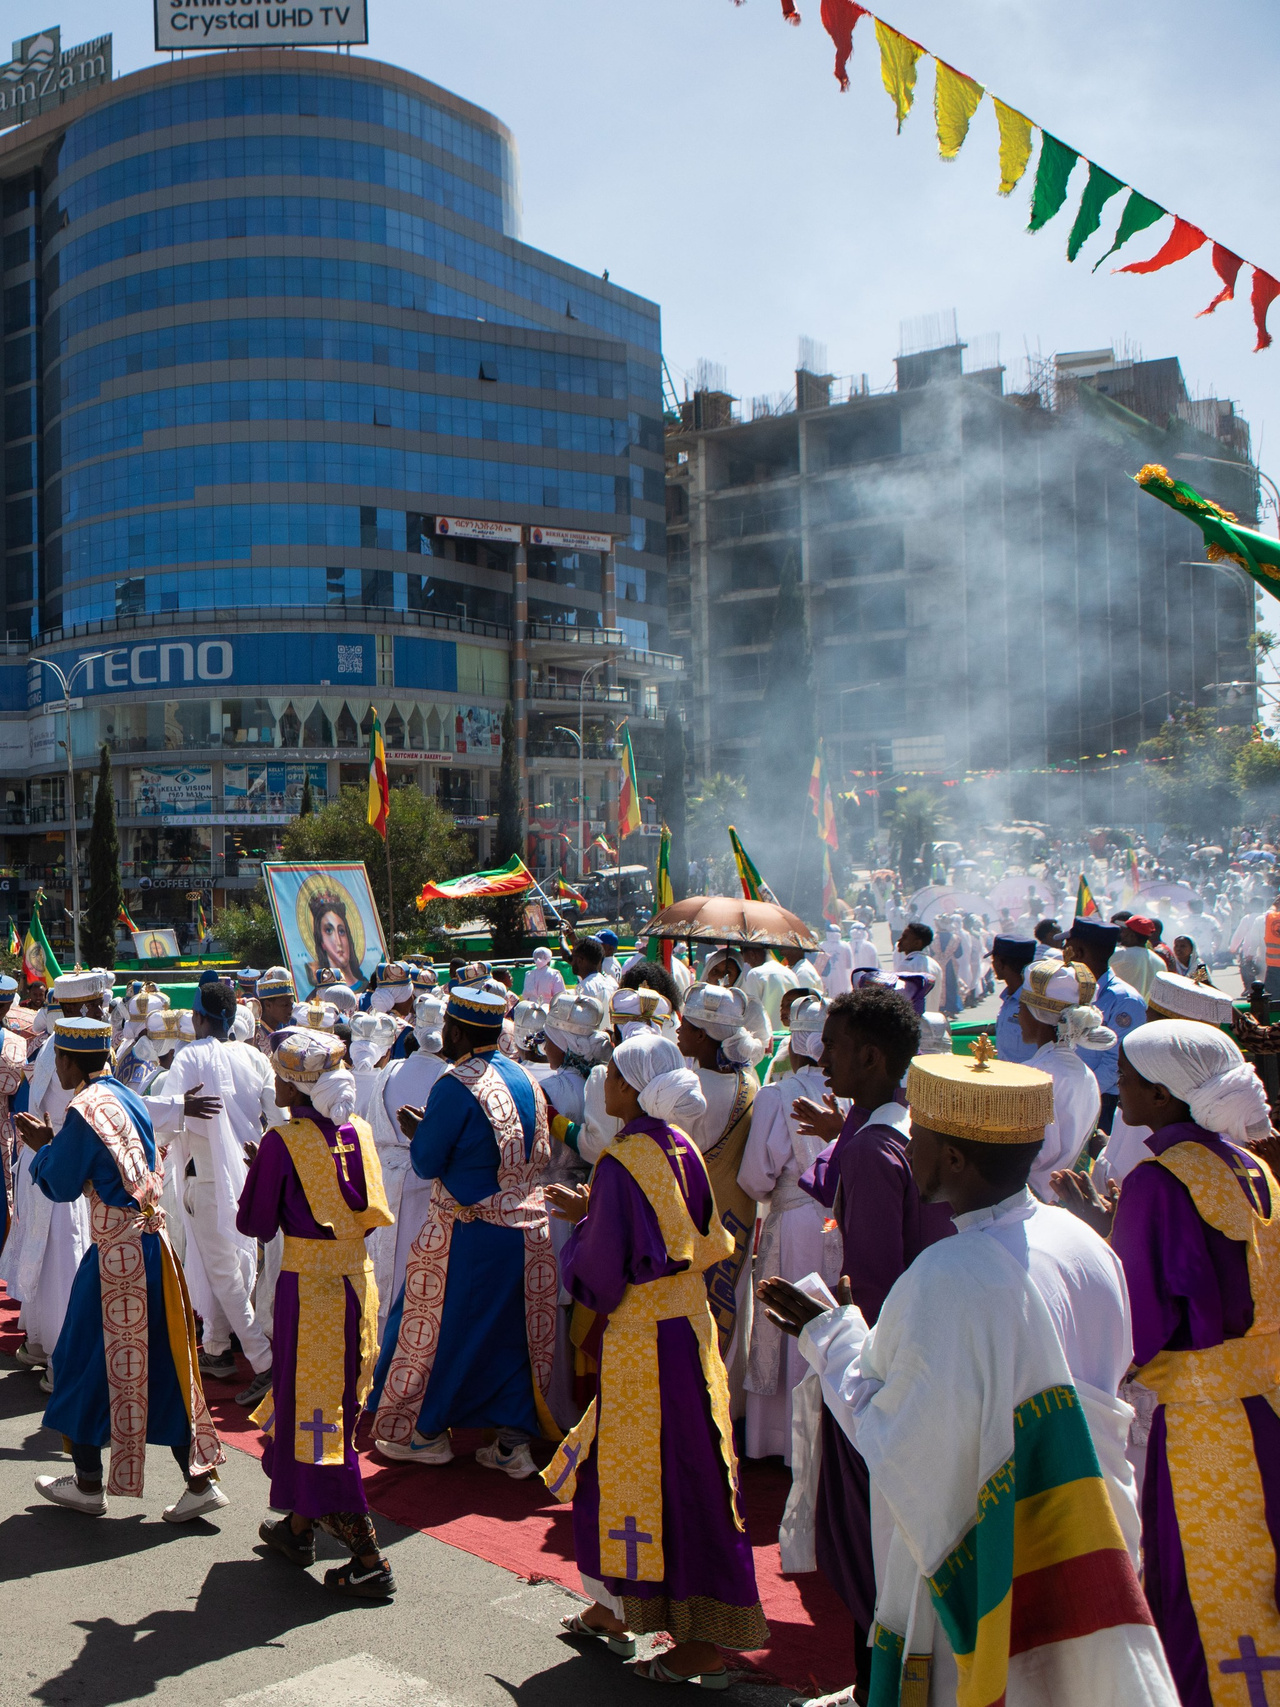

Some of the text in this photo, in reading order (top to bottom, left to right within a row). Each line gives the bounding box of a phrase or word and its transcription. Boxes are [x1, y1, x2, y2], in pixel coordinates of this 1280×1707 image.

[170, 6, 351, 37] Crystal UHD TV
[78, 640, 234, 690] TECNO
[153, 878, 218, 889] COFFEE CITY
